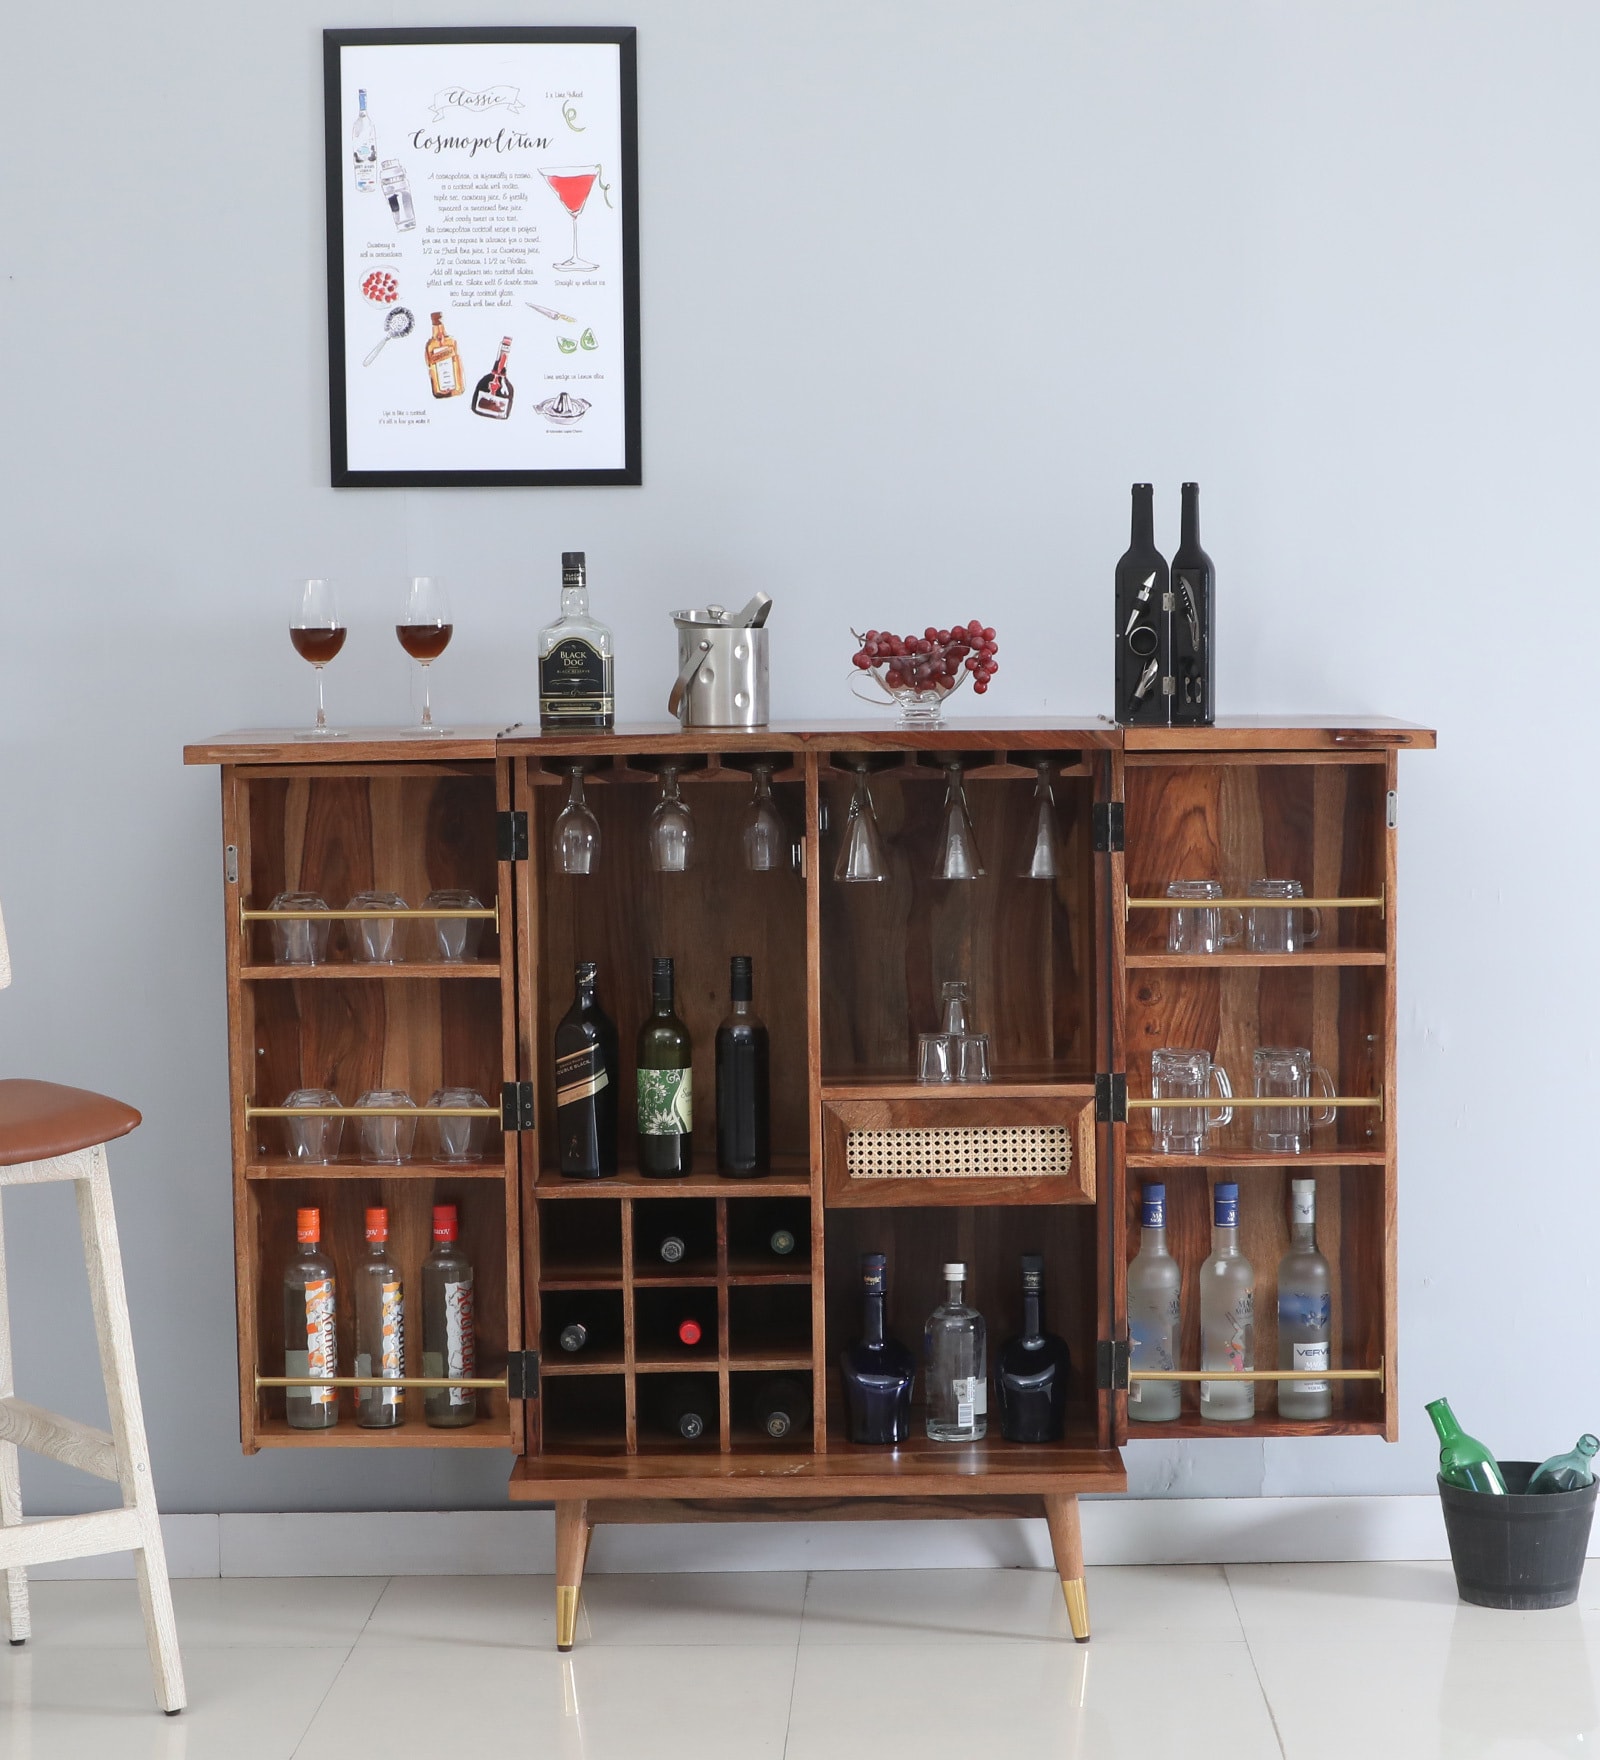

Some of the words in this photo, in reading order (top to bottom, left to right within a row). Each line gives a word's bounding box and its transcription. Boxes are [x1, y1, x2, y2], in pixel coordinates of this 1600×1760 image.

[444, 91, 507, 107] Classic
[407, 128, 554, 158] Cosmopolitan
[560, 651, 587, 659] BLACK
[573, 1059, 591, 1069] BLACK
